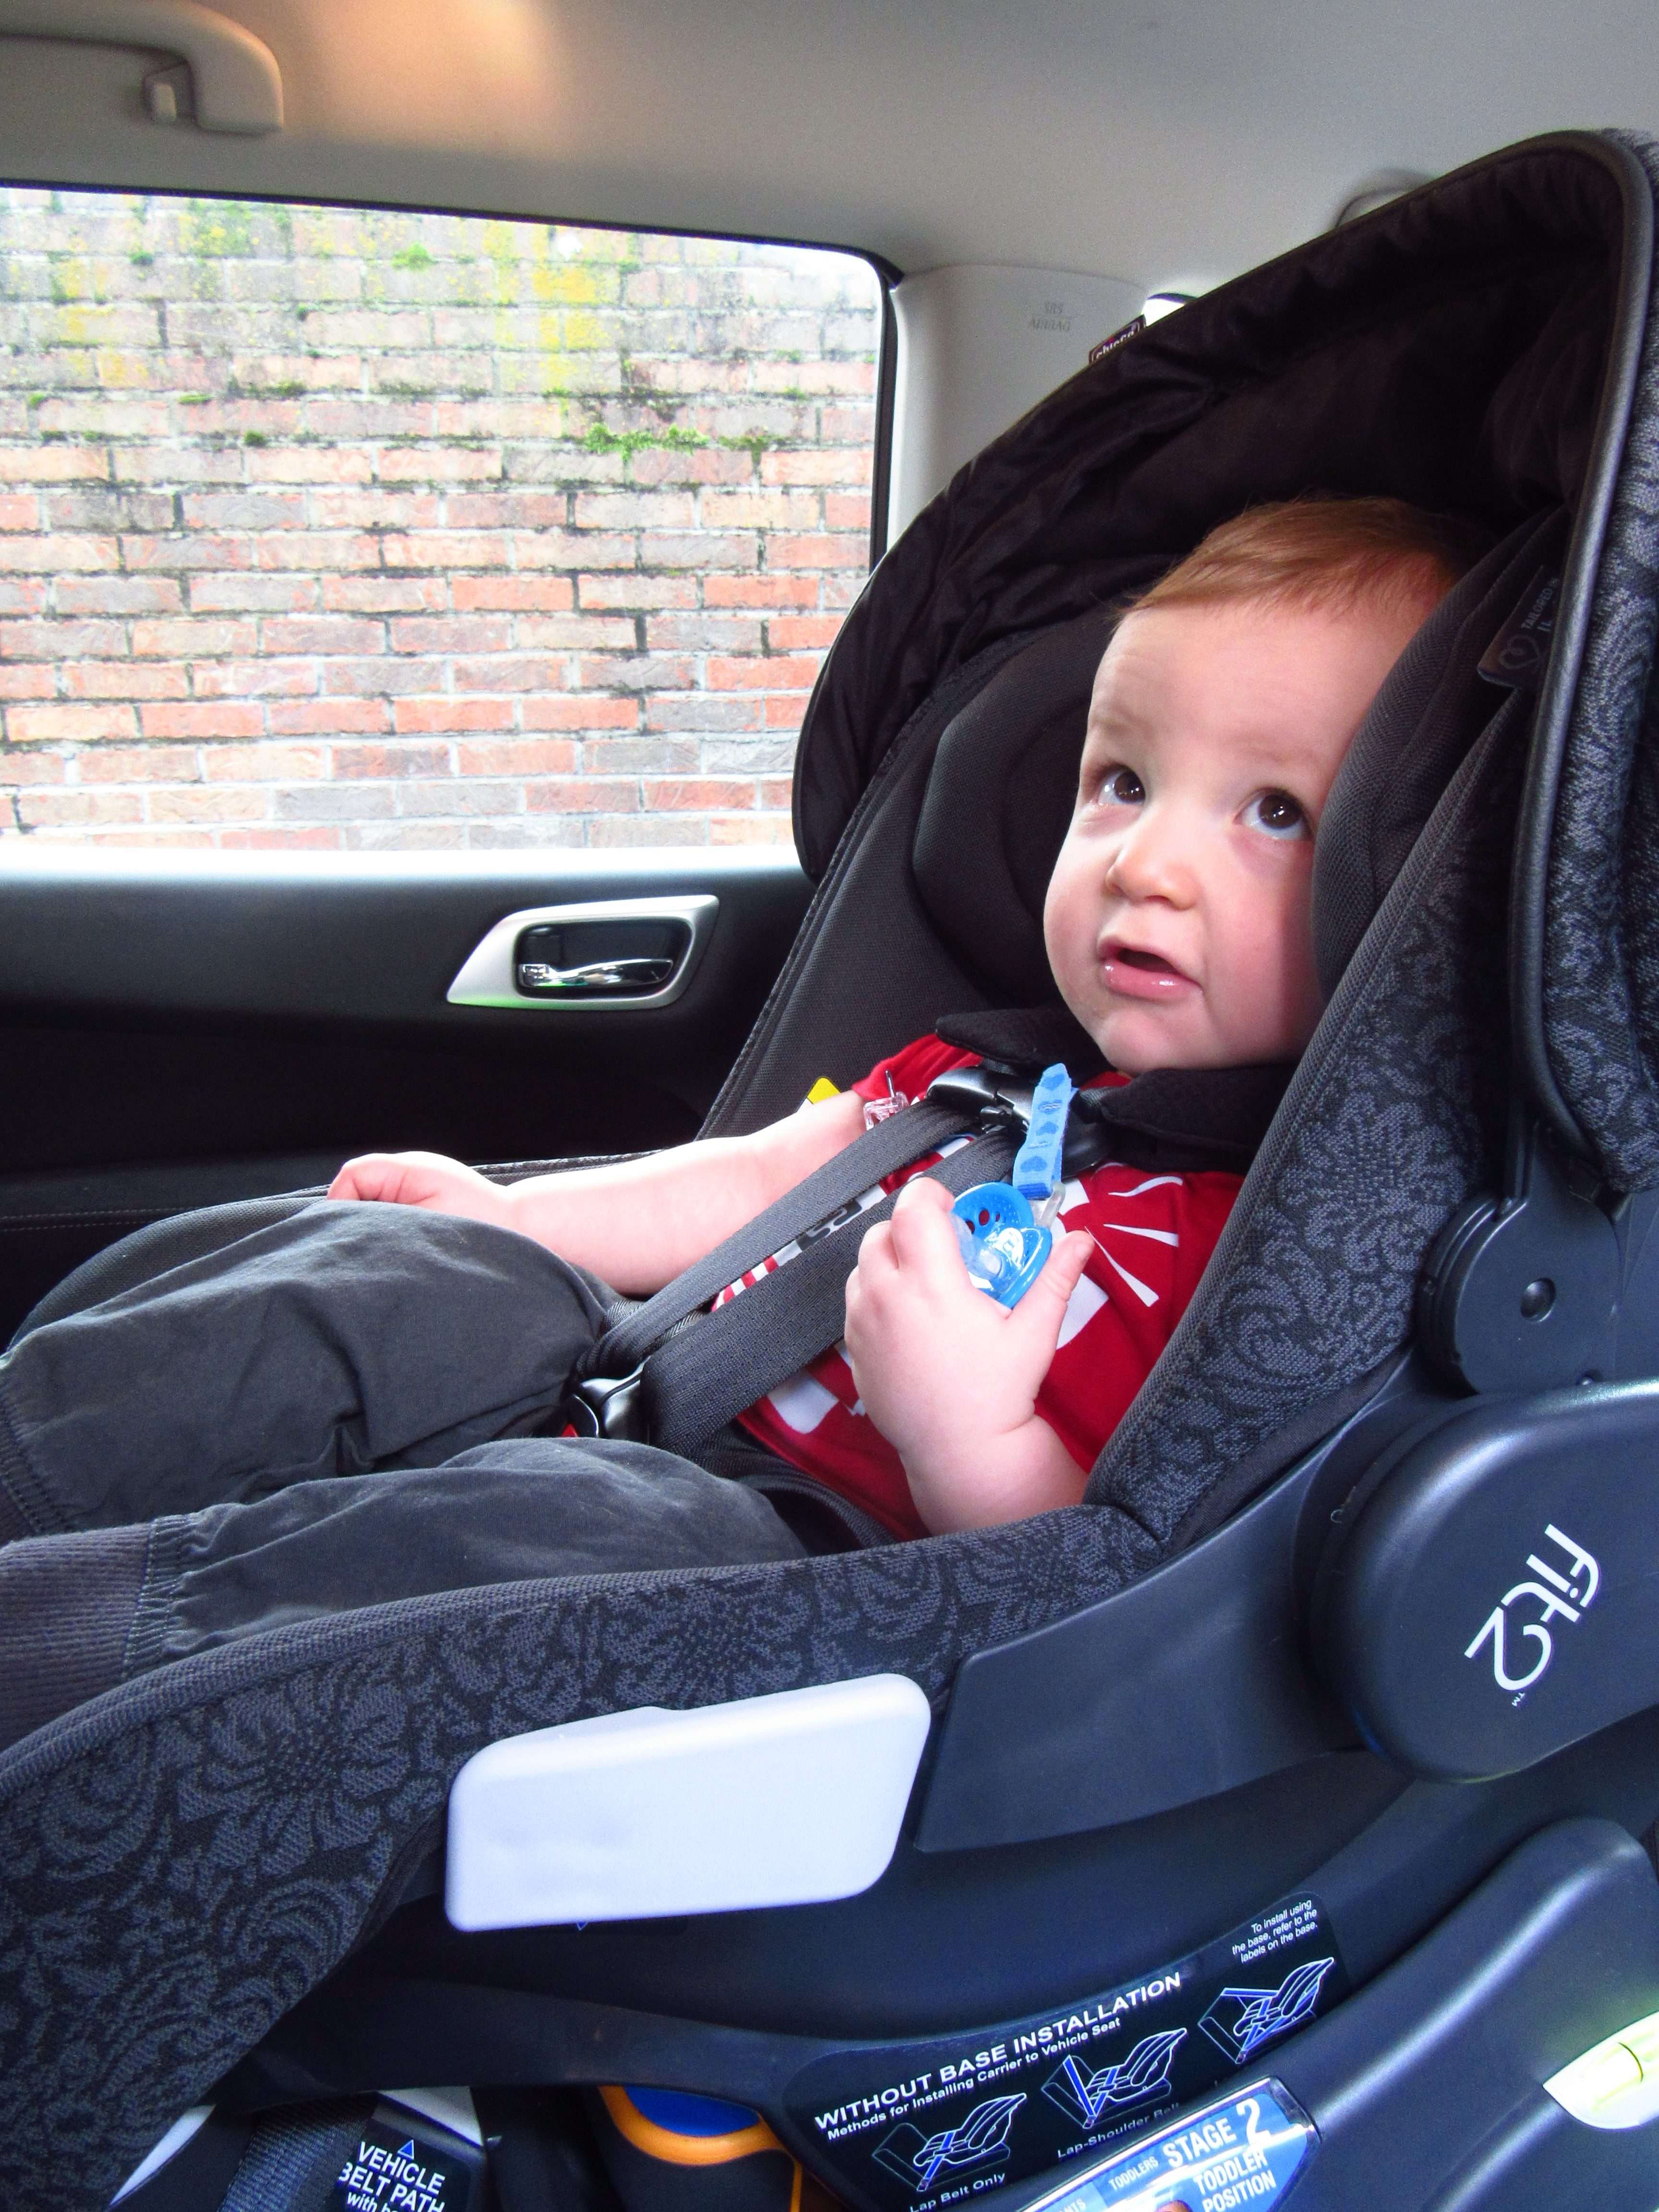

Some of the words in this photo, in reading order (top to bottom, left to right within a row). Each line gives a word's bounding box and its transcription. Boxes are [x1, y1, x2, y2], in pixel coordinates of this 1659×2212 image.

[1232, 1943, 1246, 1955] the
[1273, 1921, 1292, 1936] refer
[1294, 1916, 1302, 1928] to
[1304, 1909, 1317, 1921] the
[1251, 1923, 1262, 1934] To
[1264, 1909, 1287, 1929] install
[1289, 1900, 1312, 1917] using
[1241, 1945, 1265, 1963] labels
[1267, 1939, 1279, 1951] on
[1280, 1932, 1294, 1944] the
[1295, 1922, 1318, 1937] base.
[814, 2073, 932, 2130] WITHOUT
[939, 2044, 1007, 2083] BASE
[1013, 1972, 1181, 2054] INSTALLATION
[827, 2112, 887, 2141] Methods
[890, 2103, 909, 2117] for
[912, 2077, 974, 2109] Installing
[977, 2057, 1023, 2082] Carrier
[1025, 2051, 1039, 2062] to
[1041, 2031, 1089, 2056] Vehicle
[1092, 2017, 1121, 2035] Seat
[1057, 2115, 1150, 2159] Lap-Shoulder
[1162, 2117, 1237, 2168] STAGE
[1236, 2098, 1272, 2148] 2
[338, 2162, 391, 2197] BELT
[359, 2140, 446, 2195] VEHICLE
[1108, 2156, 1159, 2191] TODDLERS
[1193, 2148, 1268, 2196] TODDLER
[347, 2192, 378, 2212] with
[390, 2183, 445, 2212] PATH
[910, 2199, 937, 2212] Lap
[940, 2186, 969, 2203] Belt
[973, 2173, 1005, 2190] Only
[1202, 2169, 1277, 2212] POSITION
